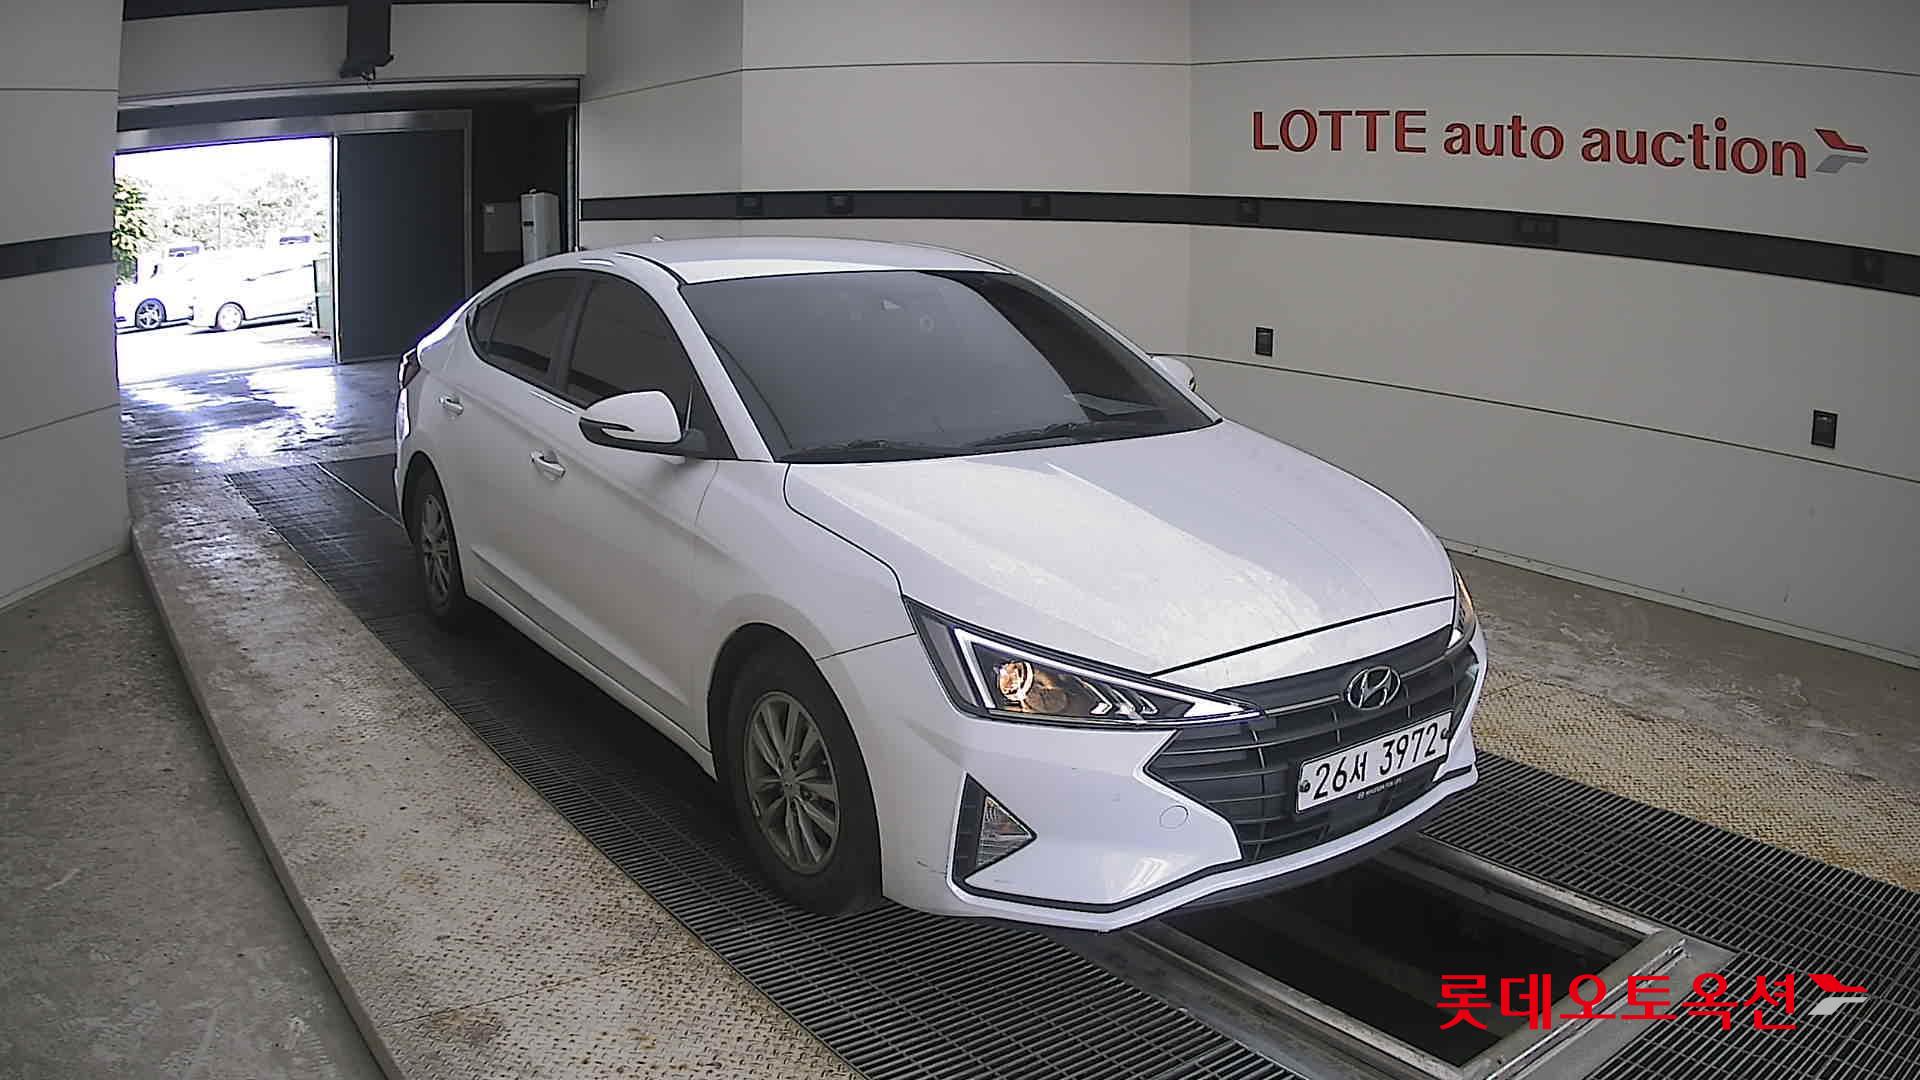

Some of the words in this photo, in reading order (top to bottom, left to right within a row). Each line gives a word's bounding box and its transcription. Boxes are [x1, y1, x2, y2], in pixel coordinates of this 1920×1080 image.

[1253, 109, 1427, 153] LOTTE
[1443, 115, 1565, 160] auto
[1581, 117, 1807, 179] auction
[1313, 752, 1368, 800] 26서
[1379, 723, 1438, 776] 3972
